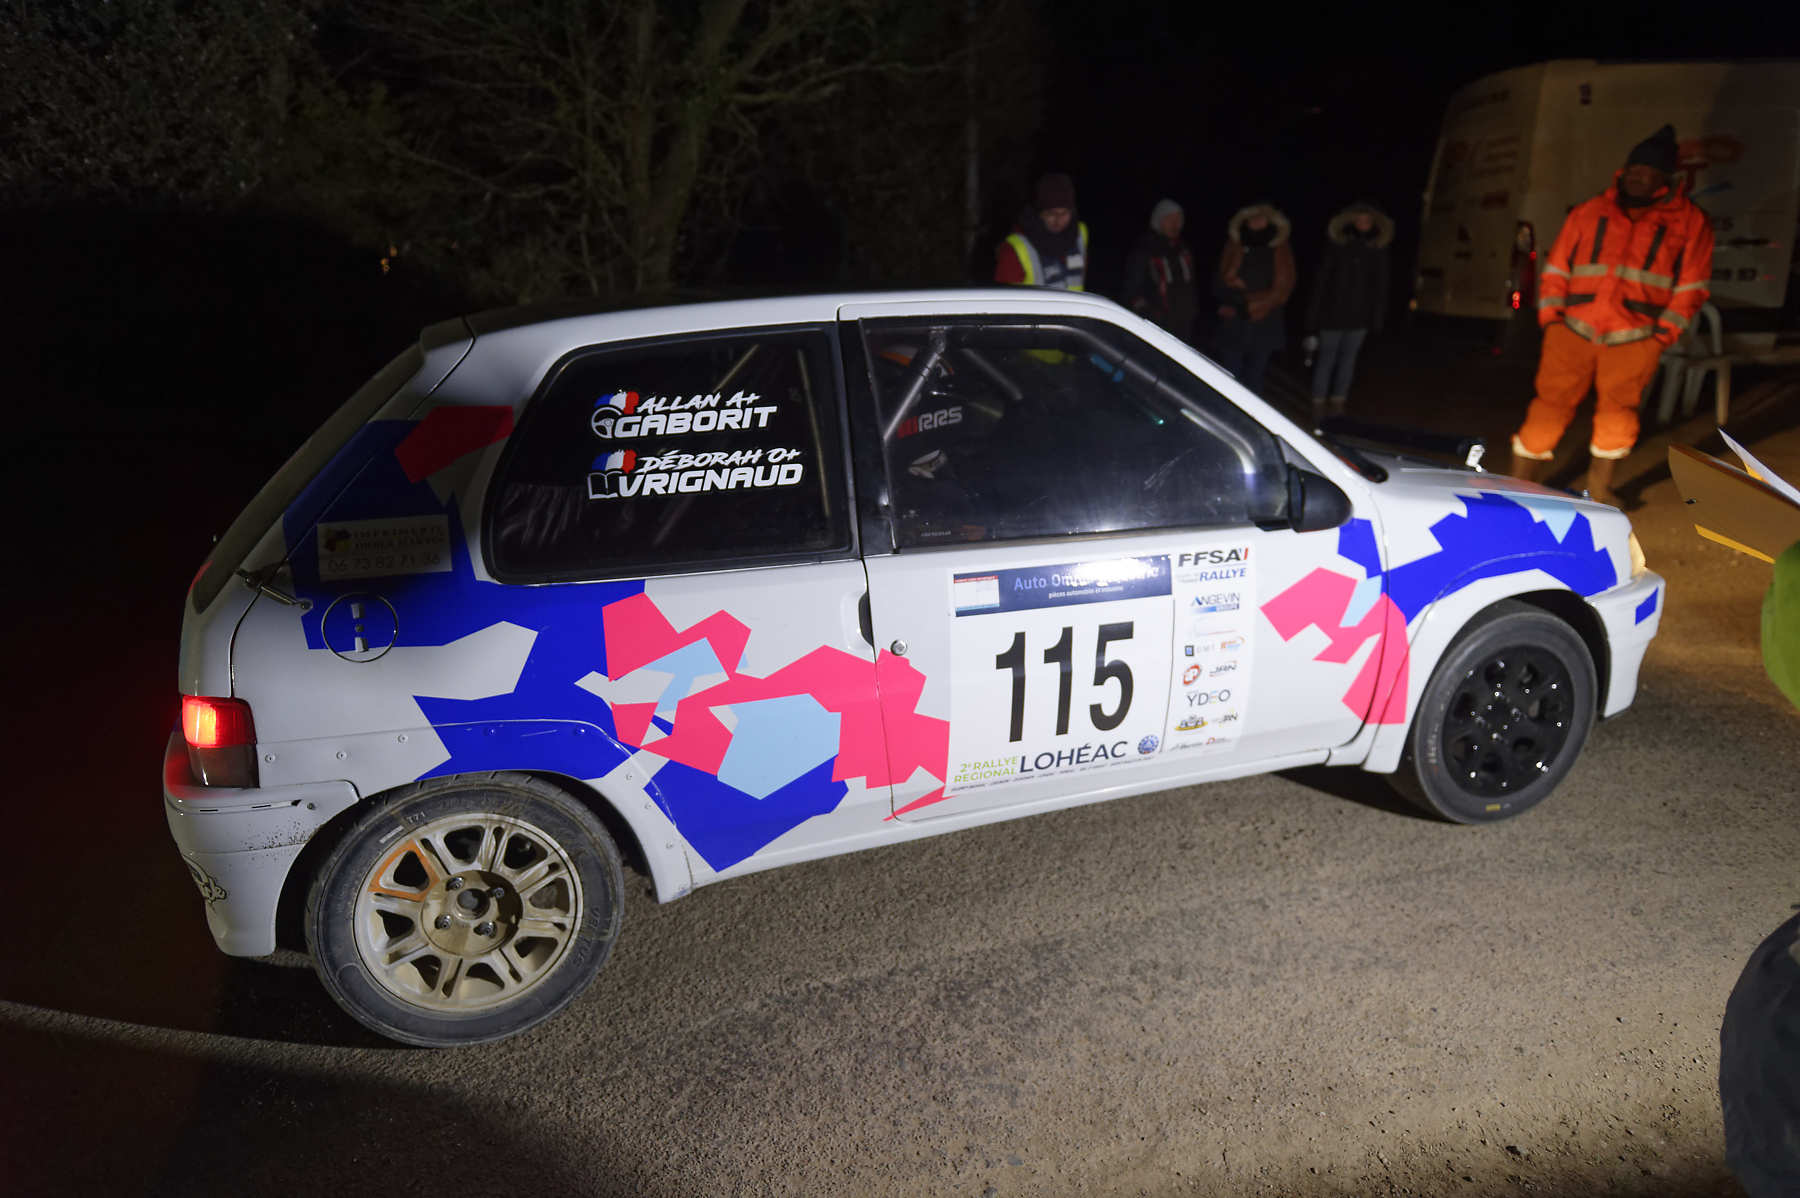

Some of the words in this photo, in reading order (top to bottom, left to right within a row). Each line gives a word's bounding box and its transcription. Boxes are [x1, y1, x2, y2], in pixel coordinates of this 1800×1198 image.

[637, 391, 721, 414] ALLAN
[614, 405, 778, 439] GABORIT
[636, 449, 763, 475] DÉBORAH
[618, 463, 804, 498] VRIGNAUD
[1178, 548, 1241, 568] FFSA
[1014, 574, 1047, 591] Auto
[1200, 567, 1246, 581] RALLYE
[995, 620, 1134, 743] 115
[1187, 689, 1231, 707] YDEO
[973, 755, 1018, 770] RALLYE
[1019, 741, 1129, 774] LOHÉAC
